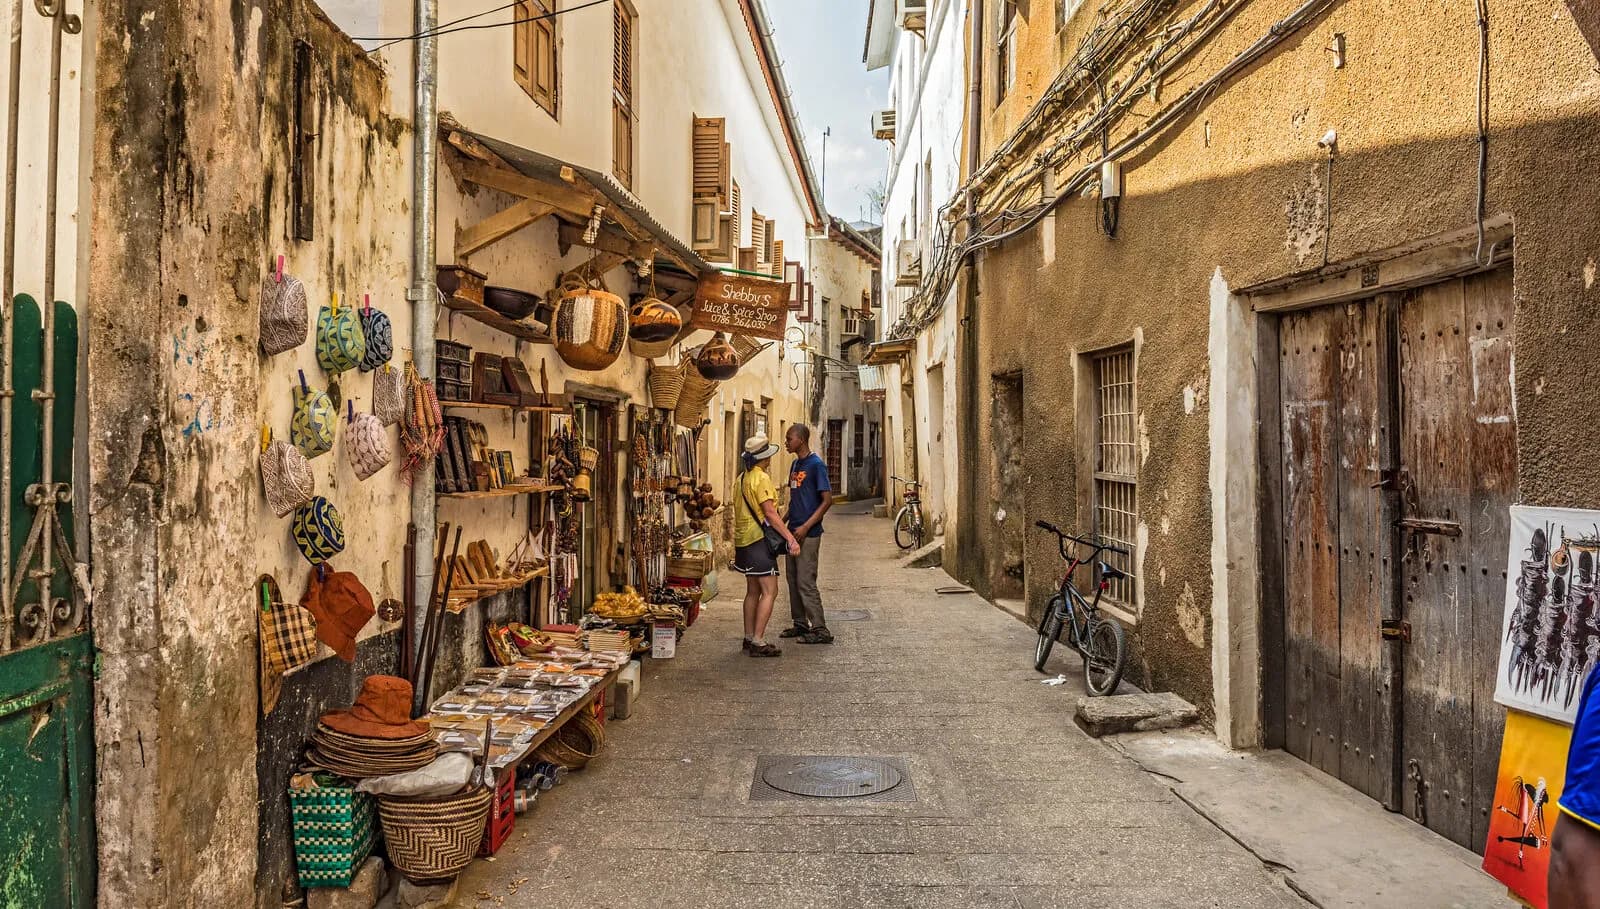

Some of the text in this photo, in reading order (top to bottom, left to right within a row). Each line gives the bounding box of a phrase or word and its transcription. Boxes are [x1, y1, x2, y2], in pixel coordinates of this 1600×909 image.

[701, 300, 777, 325] Juice & Spice Shop
[711, 314, 730, 324] 0786
